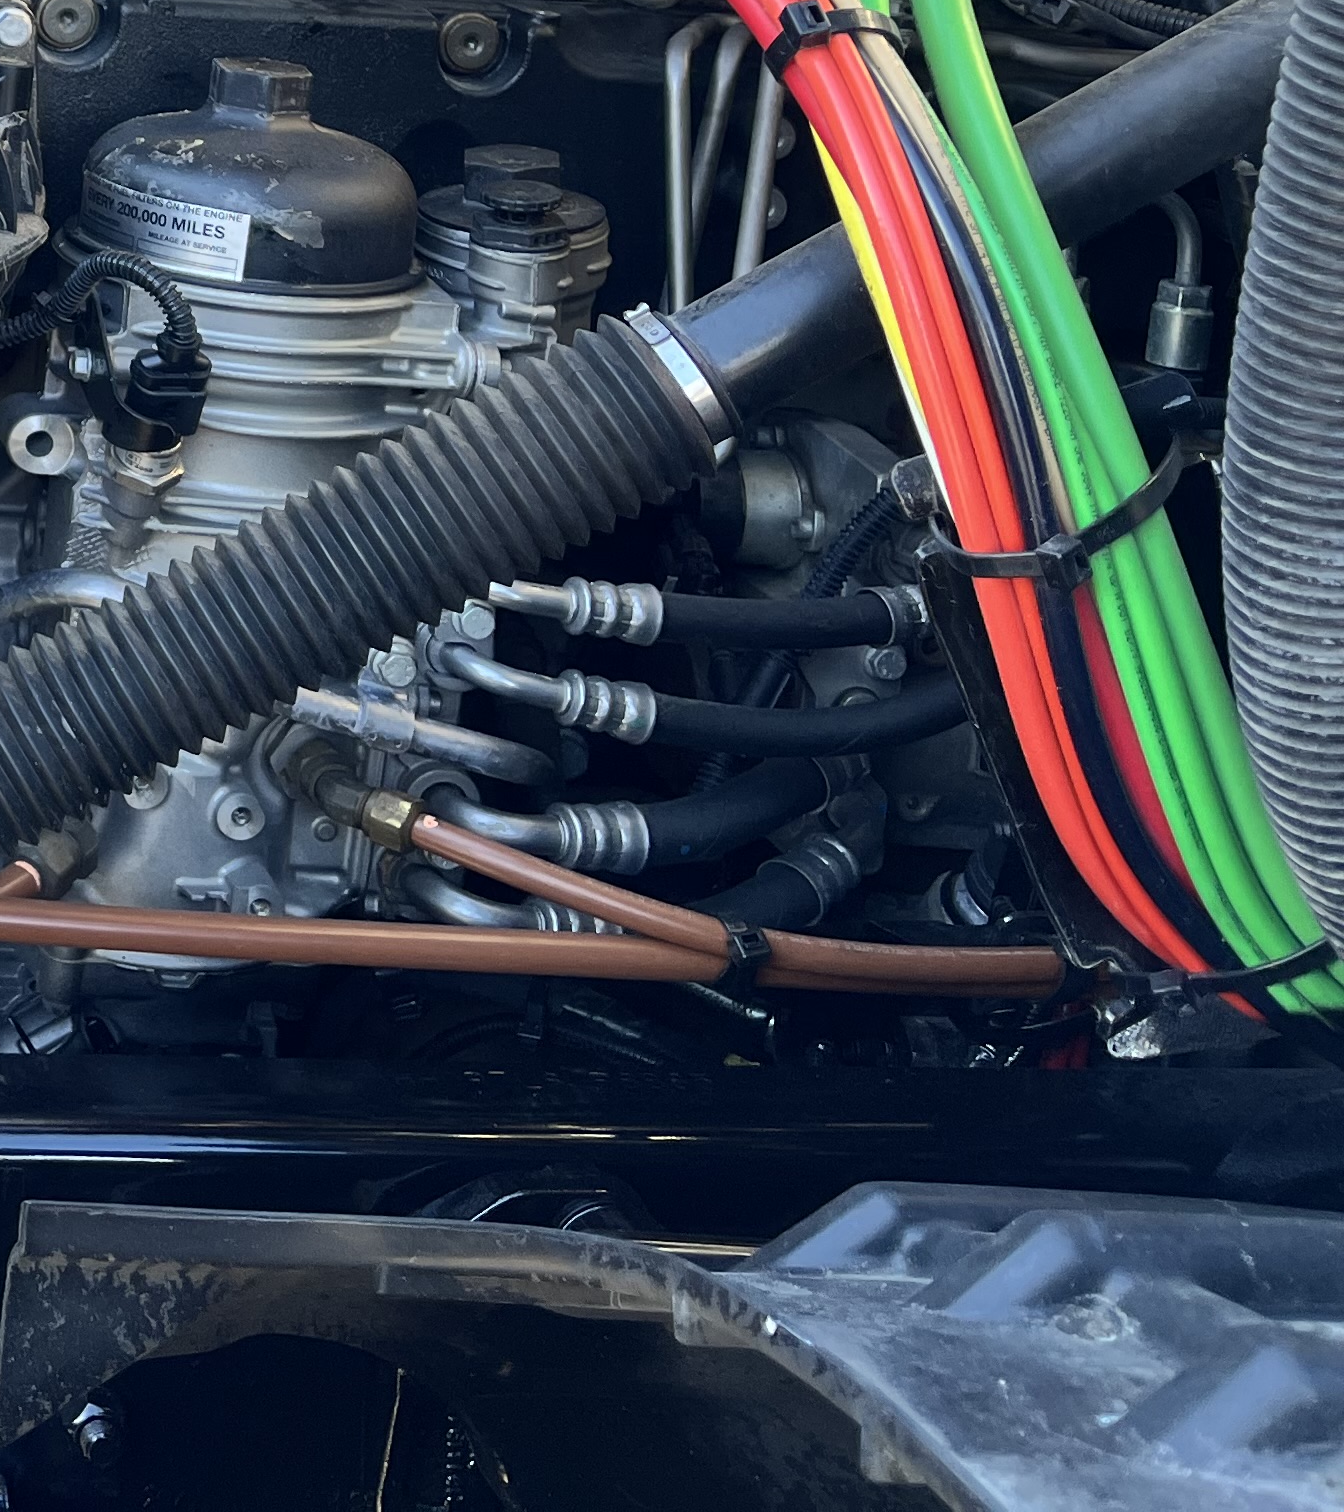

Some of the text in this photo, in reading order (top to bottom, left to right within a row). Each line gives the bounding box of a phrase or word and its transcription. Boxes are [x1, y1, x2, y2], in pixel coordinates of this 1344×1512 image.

[117, 201, 167, 227] 200,000
[172, 217, 225, 239] MILES
[132, 190, 243, 223] FILTERS ON THE ENGINE
[148, 231, 179, 245] MILEAGE
[193, 242, 227, 254] SERVICE
